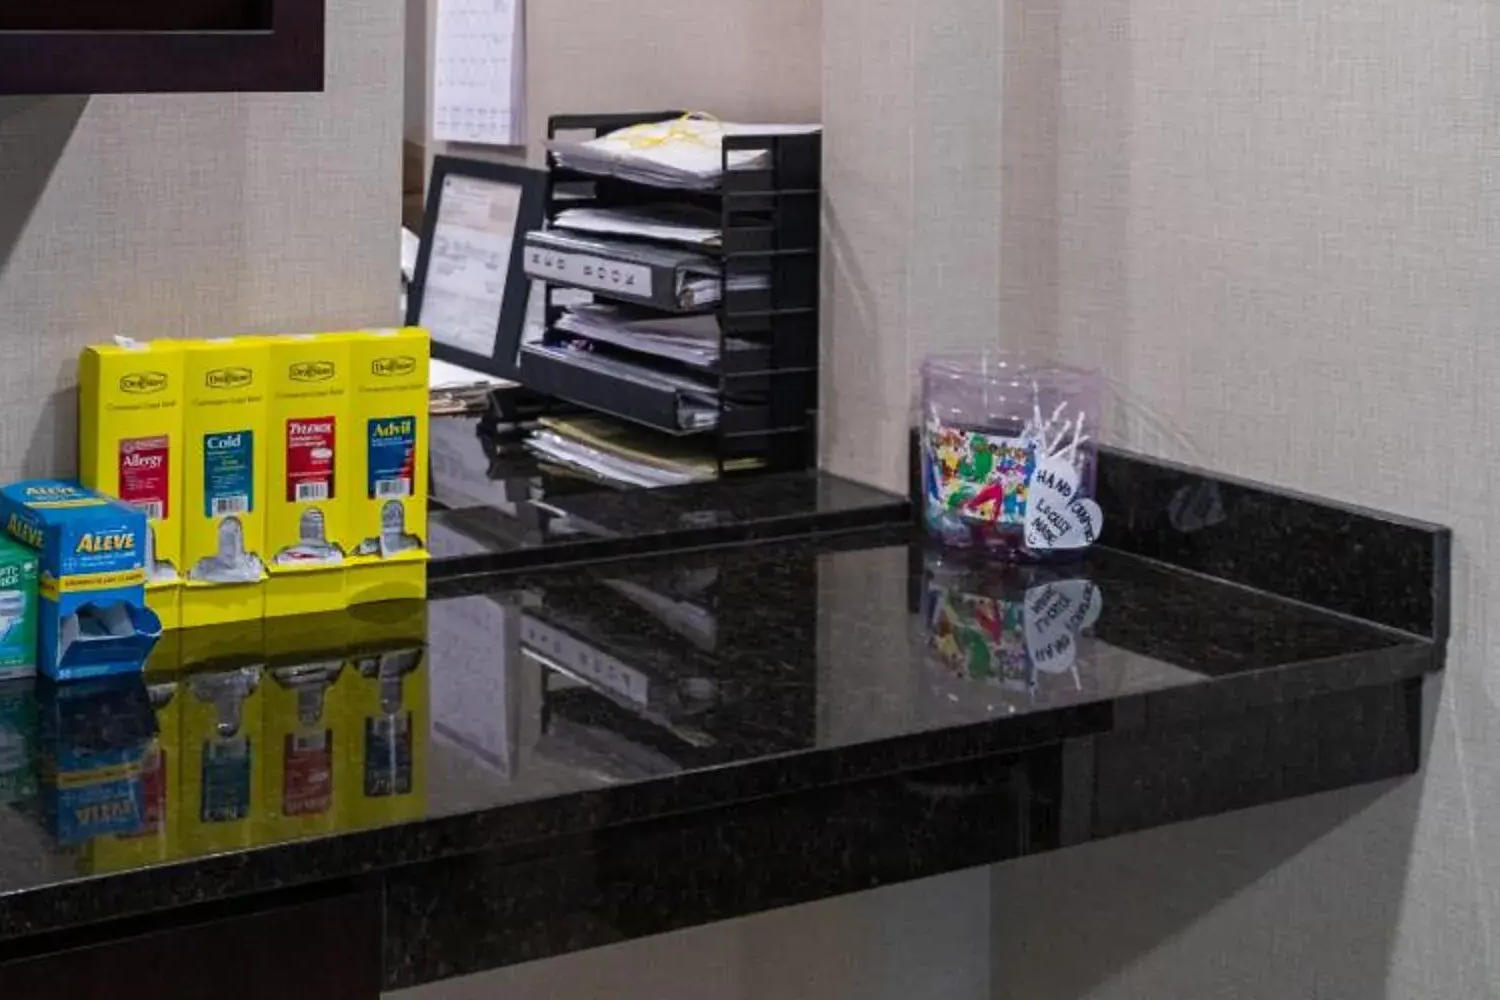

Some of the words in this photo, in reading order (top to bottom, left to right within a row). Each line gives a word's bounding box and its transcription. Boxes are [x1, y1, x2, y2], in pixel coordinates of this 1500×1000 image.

[373, 421, 412, 437] Advil
[207, 435, 241, 450] Cold
[123, 453, 163, 469] Allergy
[7, 511, 45, 550] ALEVE
[76, 532, 135, 553] ALEVE
